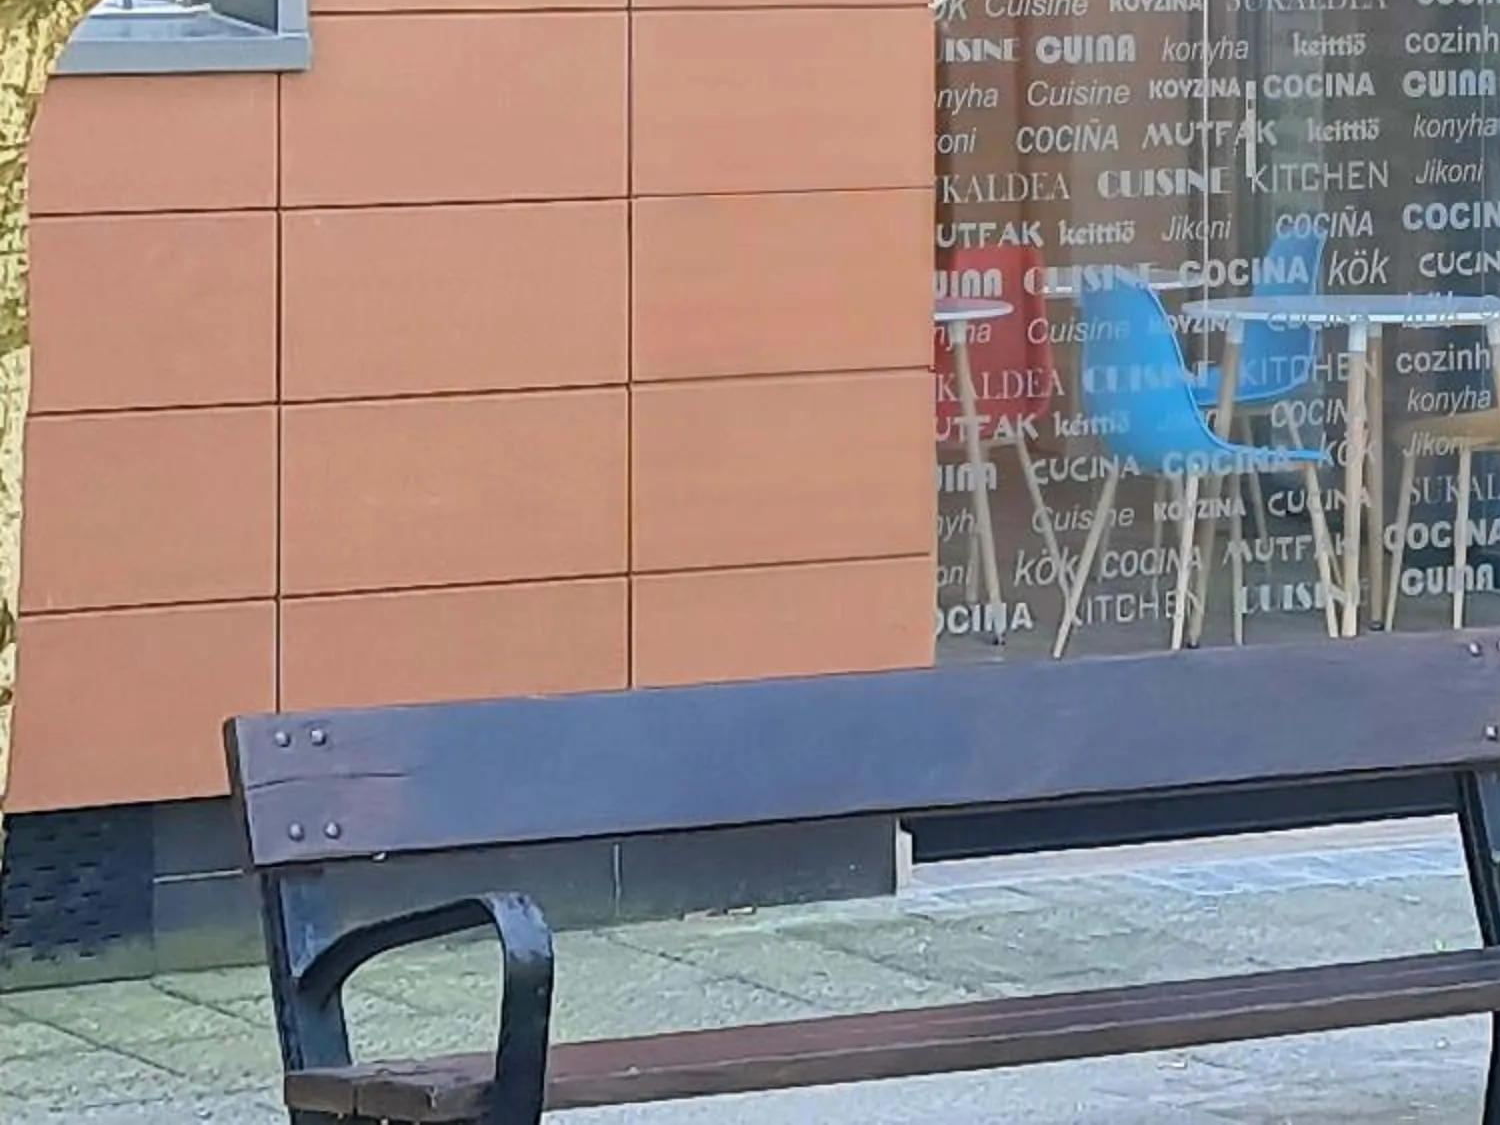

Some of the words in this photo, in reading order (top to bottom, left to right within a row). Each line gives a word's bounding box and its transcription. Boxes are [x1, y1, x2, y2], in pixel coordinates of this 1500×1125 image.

[1292, 31, 1367, 57] keittiö
[1027, 80, 1130, 107] Cuisine
[1263, 72, 1376, 99] COCINA
[1307, 118, 1380, 142] keittiö
[1413, 113, 1499, 140] konyha
[1098, 168, 1233, 199] CUISINE
[1251, 160, 1389, 195] KITCHEN
[1415, 159, 1484, 184] Jikoni
[1058, 220, 1137, 246] keittiö
[1161, 214, 1232, 242] Jikoni
[1180, 257, 1309, 288] COCINA
[1328, 248, 1391, 286] kök
[1396, 345, 1500, 375] cozinh
[1407, 387, 1491, 416] konyha
